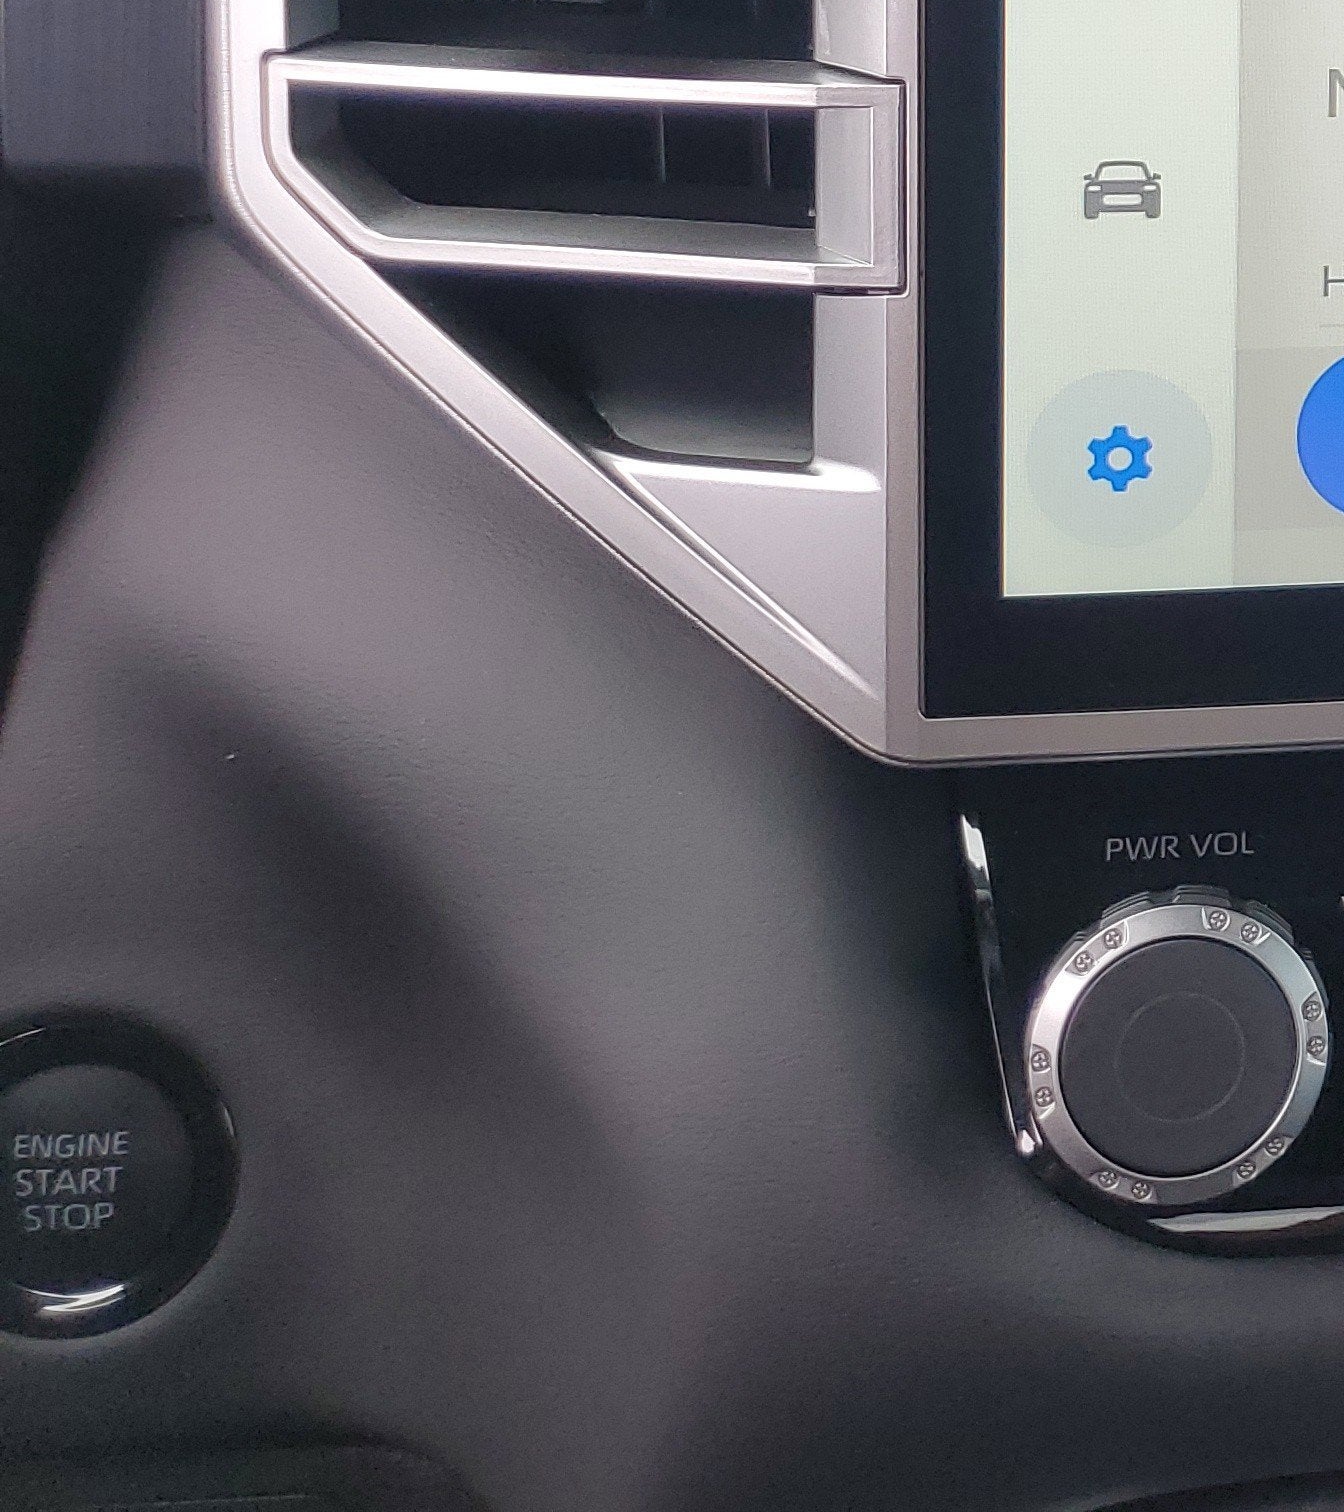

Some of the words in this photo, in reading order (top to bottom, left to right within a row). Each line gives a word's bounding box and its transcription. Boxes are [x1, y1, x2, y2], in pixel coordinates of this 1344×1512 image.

[1106, 835, 1180, 862] PWR
[1189, 831, 1255, 858] VOL
[13, 1131, 130, 1160] ENGINE
[14, 1166, 124, 1197] START
[24, 1202, 115, 1231] STOP
